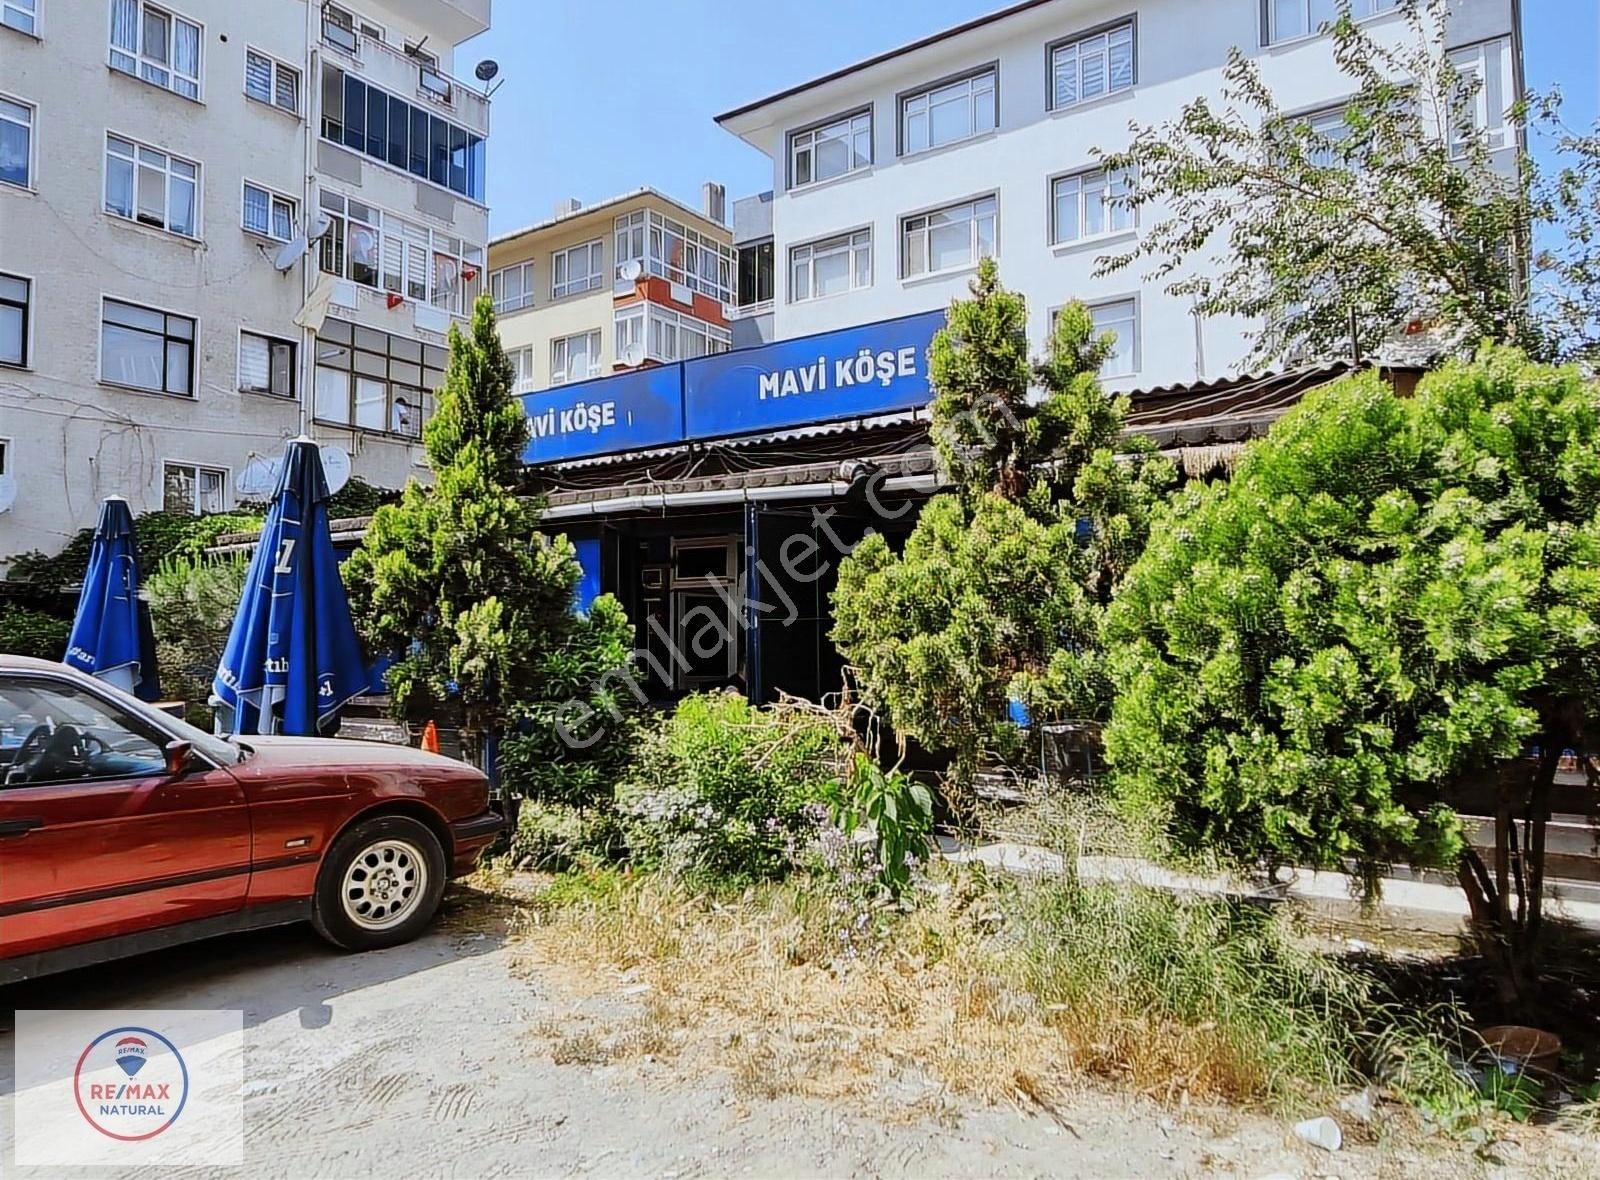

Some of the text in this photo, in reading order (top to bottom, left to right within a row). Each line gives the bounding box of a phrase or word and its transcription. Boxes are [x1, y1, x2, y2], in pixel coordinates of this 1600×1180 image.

[759, 356, 827, 400] MAVİ
[835, 346, 916, 387] KÖŞE
[525, 401, 616, 439] AVİ KÖŞE
